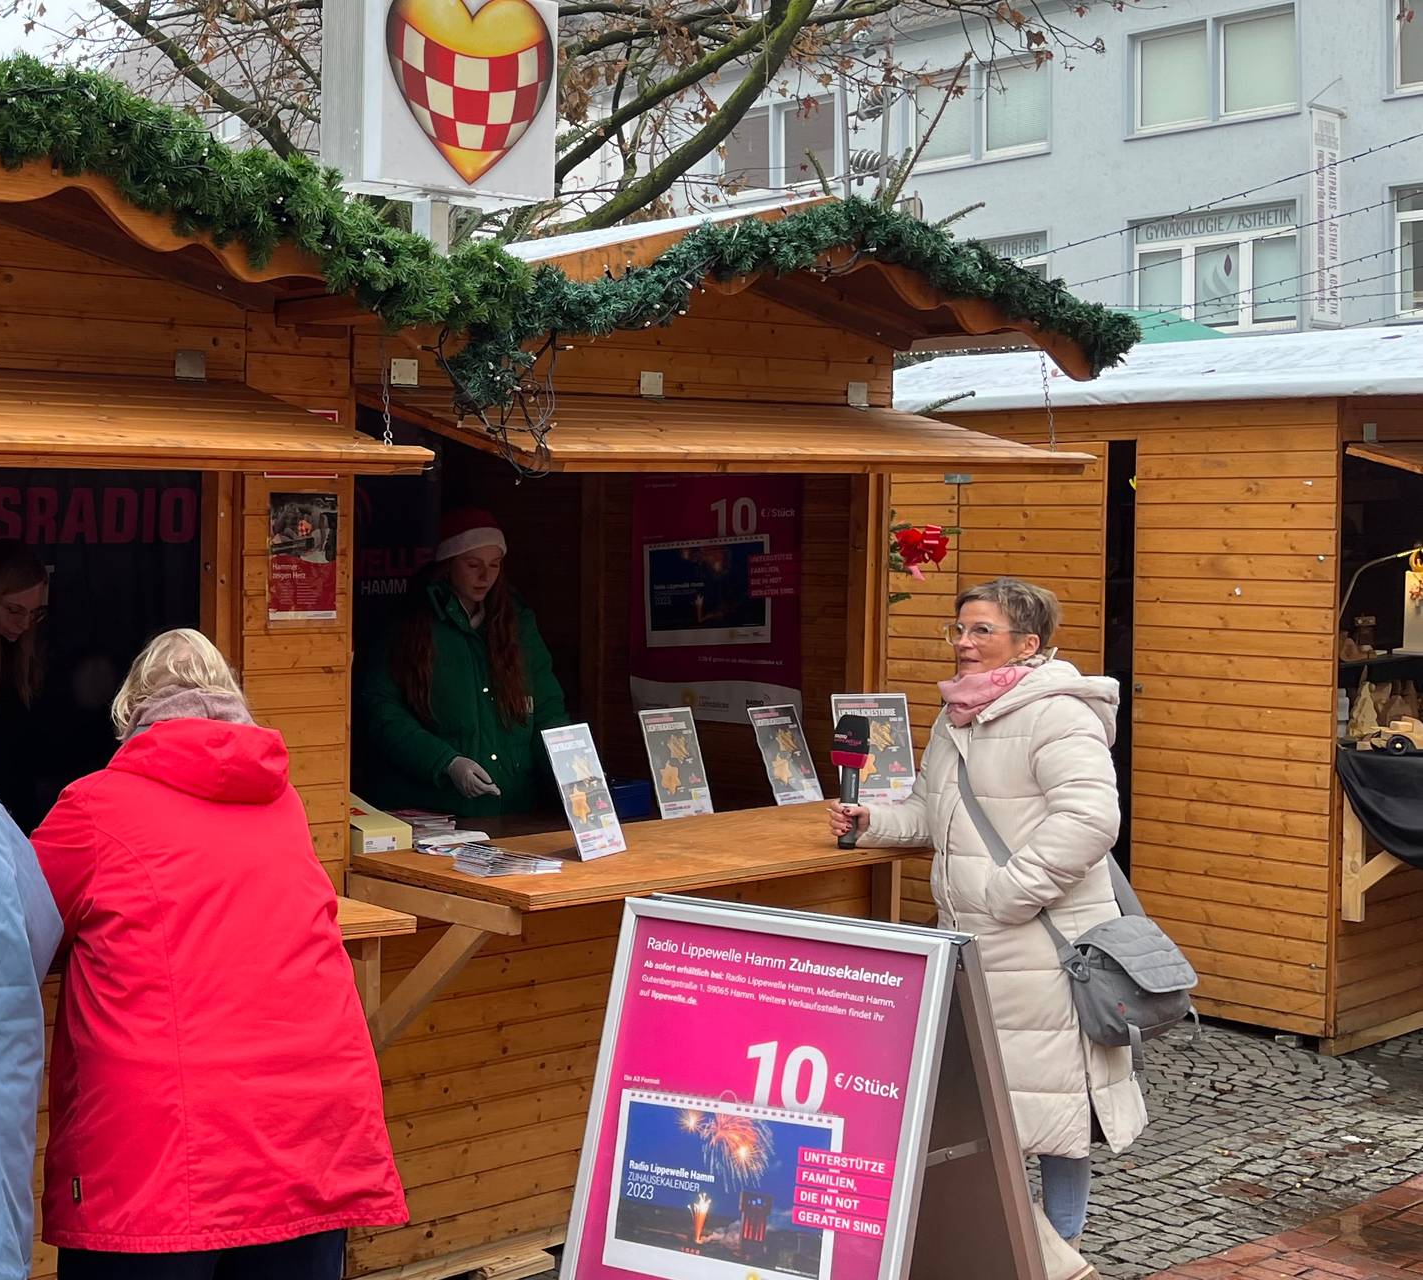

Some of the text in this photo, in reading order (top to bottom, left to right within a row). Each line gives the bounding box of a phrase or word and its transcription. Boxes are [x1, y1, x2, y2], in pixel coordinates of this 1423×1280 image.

[1145, 216, 1224, 241] GYNÄKOLOGIE
[1237, 207, 1292, 230] ÄSTHETIK
[710, 497, 758, 537] 10
[360, 578, 408, 596] HAMM
[647, 937, 904, 987] Radio Lippewelle Hamm Zuhausekalender
[639, 989, 650, 997] auf
[644, 960, 653, 969] Ab
[655, 962, 676, 972] sofort
[677, 965, 709, 978] erhältlich
[725, 973, 746, 983] Radio
[748, 976, 786, 990] Lippewelle
[788, 982, 815, 995] Hamm,
[817, 987, 865, 1002] Medienhaus
[866, 995, 896, 1008] Hamm,
[641, 974, 697, 990] Gutenbergstraße
[707, 985, 729, 996] 59065
[730, 988, 756, 1001] Hamm.
[758, 993, 786, 1006] Weitere
[788, 998, 847, 1016] Verkaufsstellen
[848, 1008, 872, 1020] findet
[873, 1012, 885, 1022] ihr
[747, 1041, 900, 1113] 10 €/Stück
[629, 1160, 715, 1183] Radio Lippewelle Hamm
[803, 1151, 886, 1174] UNTERSTÜTZE
[626, 1181, 655, 1200] 2023
[628, 1171, 700, 1192] ZUHAUSEKALENDER
[801, 1171, 857, 1191] FAMILIEN,
[800, 1191, 860, 1210] DIE IN NOT
[798, 1211, 884, 1236] GERATEN SIND.
